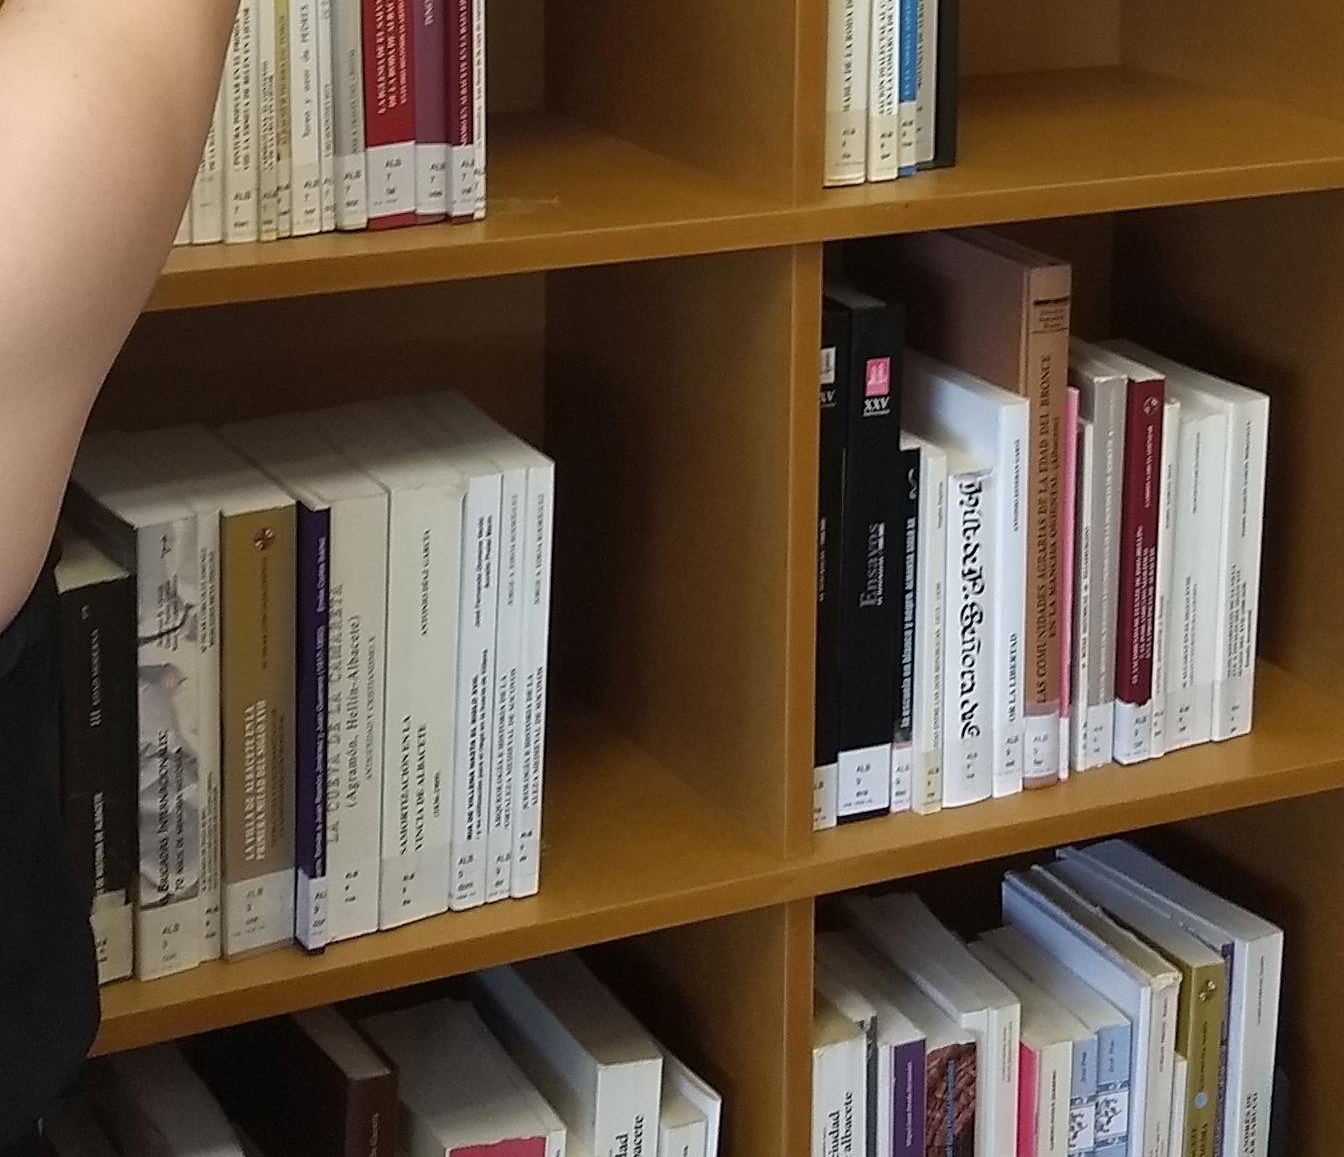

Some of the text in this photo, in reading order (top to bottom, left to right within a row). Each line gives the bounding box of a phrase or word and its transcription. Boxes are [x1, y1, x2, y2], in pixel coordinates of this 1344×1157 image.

[1036, 353, 1051, 702] LAS COMUNIDADES AGRARIAS DE LA EDAD DEL BRONCE
[400, 714, 410, 732] LA
[400, 734, 410, 752] EN
[415, 722, 425, 784] ALBACETE
[415, 788, 425, 804] DE
[840, 1091, 852, 1151] albacete
